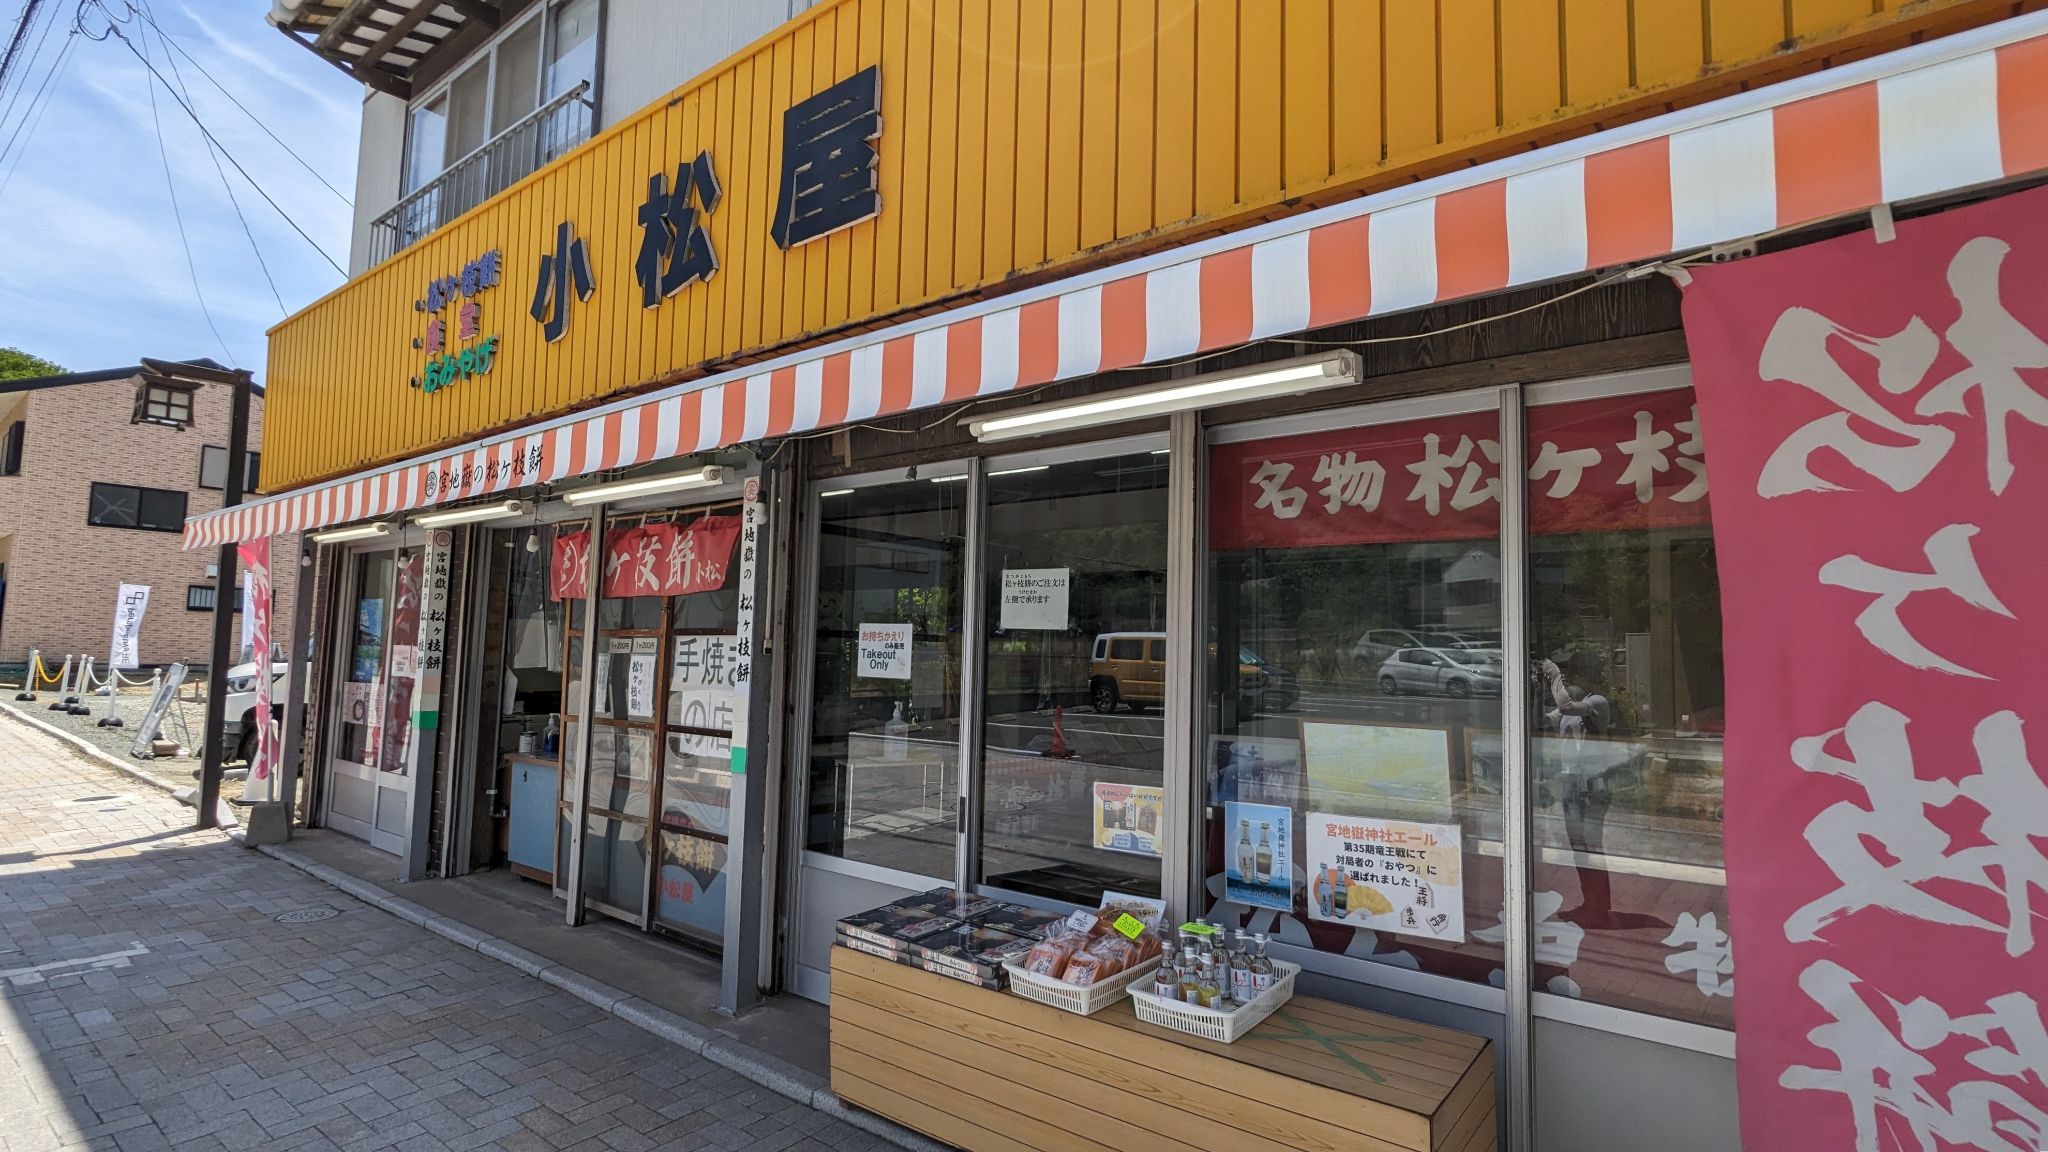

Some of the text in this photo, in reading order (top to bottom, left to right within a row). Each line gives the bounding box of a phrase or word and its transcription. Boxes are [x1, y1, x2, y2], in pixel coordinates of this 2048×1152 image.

[530, 64, 883, 344] 小松屋
[423, 334, 500, 394] おみやげ
[440, 444, 544, 494] 宮地嶽の松ヶ枝餅
[1249, 432, 1386, 520] 名物
[1005, 578, 1066, 588] 松ヶ枝餅のご注文は
[737, 506, 755, 683] 宮地嶽の松ヶ枝餅
[1004, 595, 1051, 604] 左側で承ります
[426, 551, 448, 670] 宮地嶽の松ヶ枝餅
[861, 631, 905, 642] お持ちかえり
[861, 648, 896, 660] Takeout
[870, 659, 889, 671] Only
[1325, 823, 1438, 847] 宮地嶽神社エール
[1343, 841, 1427, 860] 第35期竜王戦にて
[1415, 886, 1428, 907] 王将
